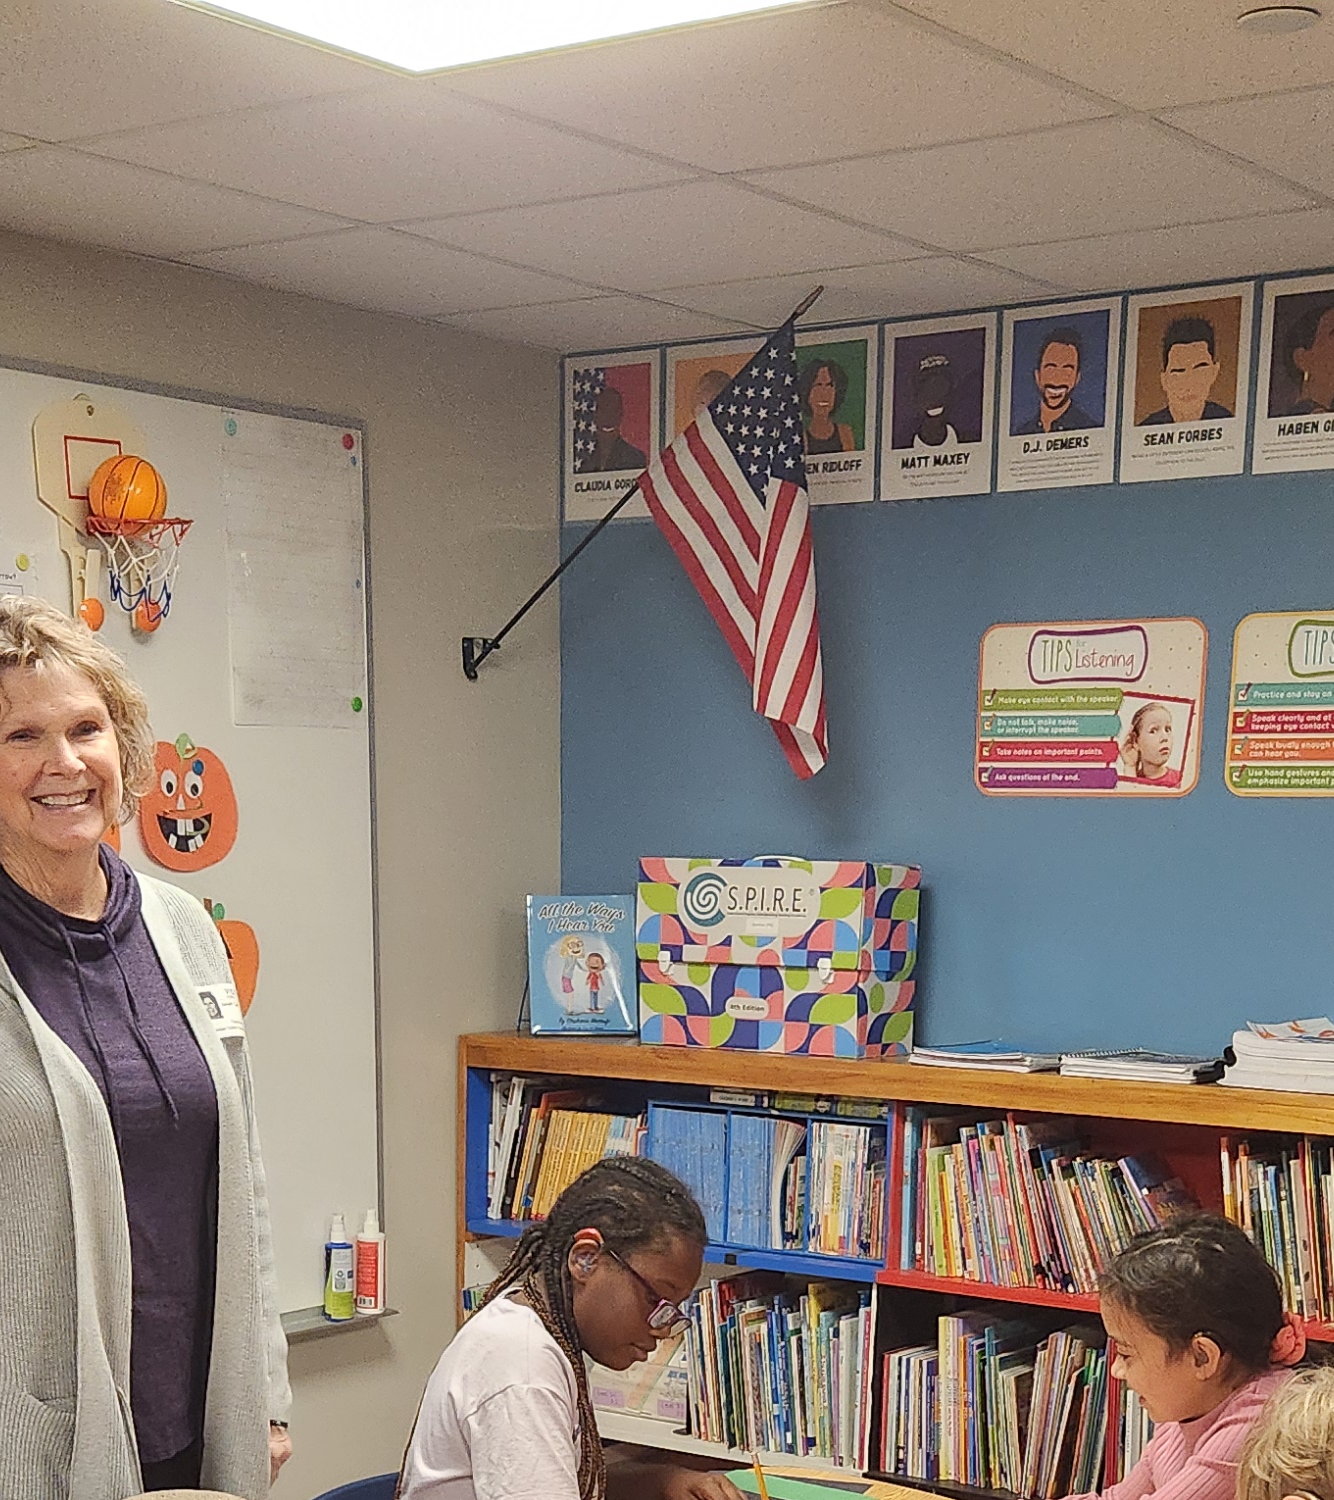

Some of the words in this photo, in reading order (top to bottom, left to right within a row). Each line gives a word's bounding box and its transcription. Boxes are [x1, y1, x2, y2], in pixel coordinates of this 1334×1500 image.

[1278, 420, 1318, 437] HABEN
[1143, 431, 1175, 446] SEAN
[1178, 427, 1223, 444] FORBES
[1023, 440, 1043, 454] D.J.
[1046, 436, 1089, 451] DEMERS
[822, 459, 863, 474] RIDLOFF
[901, 455, 930, 469] MATT
[933, 453, 971, 467] MAXEY
[574, 480, 612, 493] CLAUDIA
[1042, 639, 1073, 673] TIPS
[1076, 649, 1135, 676] Listening
[998, 695, 1017, 704] Make
[1018, 697, 1032, 706] eye
[1033, 695, 1060, 704] contact
[1062, 695, 1075, 703] with
[1076, 695, 1088, 703] the
[1253, 690, 1284, 699] Practice
[1286, 691, 1302, 699] and
[1303, 691, 1320, 700] stay
[1037, 718, 1057, 726] make
[1252, 714, 1276, 723] Speak
[1277, 713, 1304, 723] clearly
[1005, 725, 1036, 736] interrupt
[1037, 726, 1049, 734] the
[1251, 722, 1281, 732] keeping
[1283, 723, 1298, 731] eye
[1299, 722, 1329, 730] contact
[1249, 741, 1274, 750] Speak
[1275, 740, 1300, 750] loudly
[1301, 741, 1331, 750] enough
[1043, 748, 1078, 758] important
[994, 773, 1007, 781] Ask
[1008, 773, 1041, 783] questions
[1051, 773, 1063, 781] the
[1285, 769, 1319, 778] gestures
[1247, 776, 1289, 786] emphasize
[1290, 777, 1330, 786] important
[727, 886, 807, 913] S.P.I.R.E.
[539, 902, 560, 919] All
[562, 901, 584, 916] the
[587, 902, 625, 921] Ways
[556, 919, 589, 932] Hear
[592, 920, 616, 933] You
